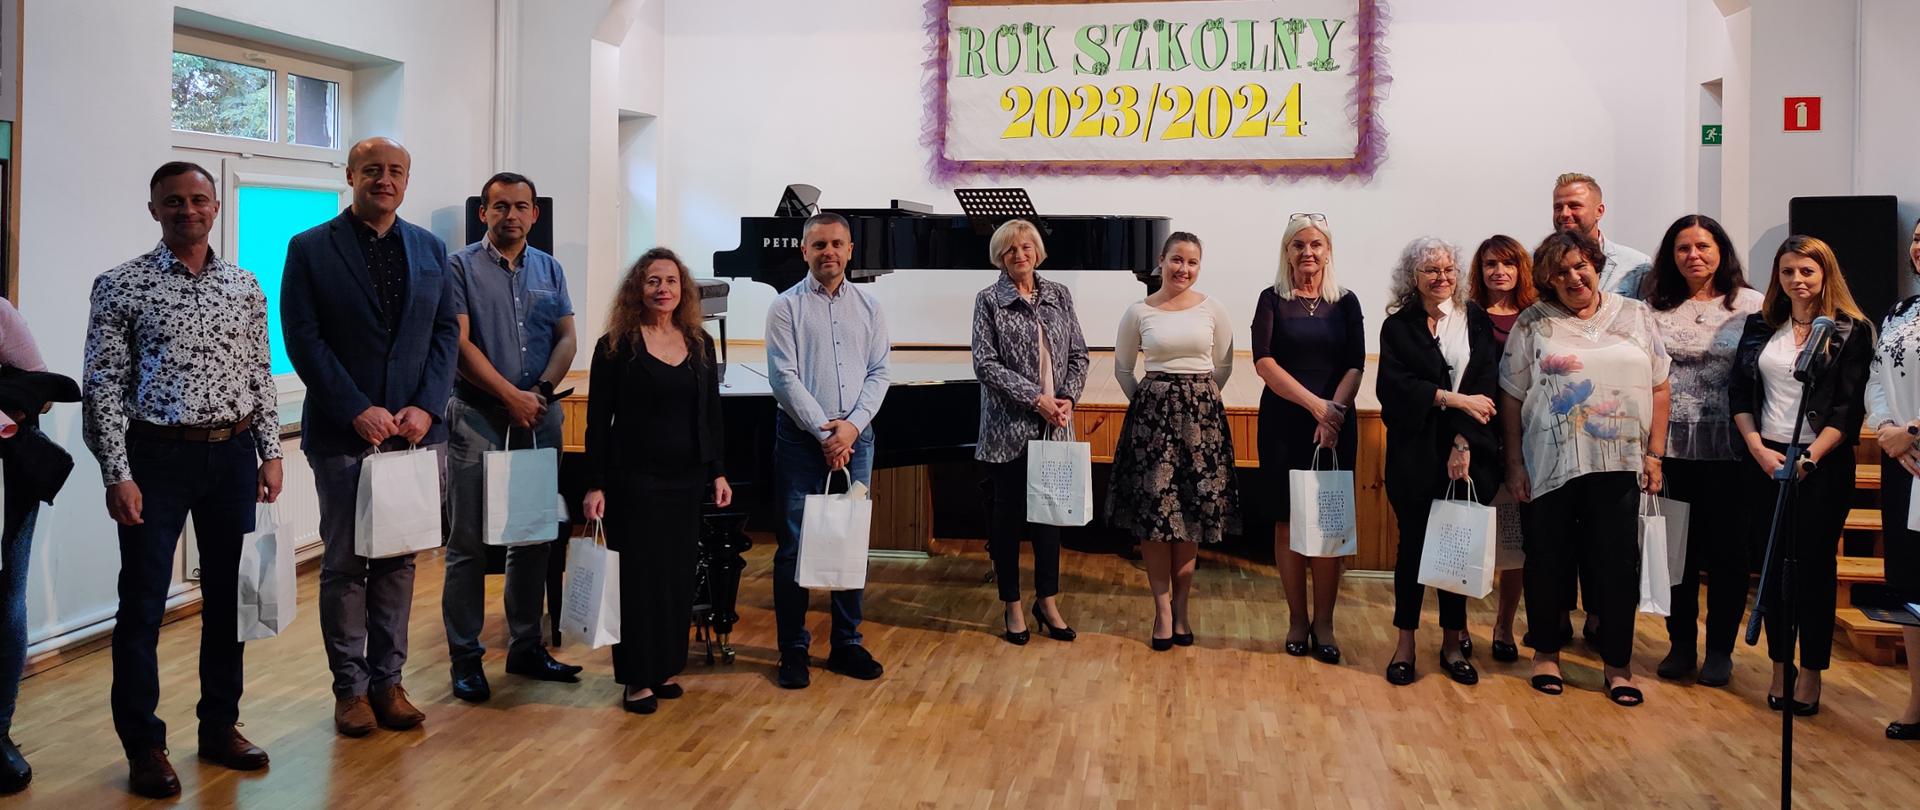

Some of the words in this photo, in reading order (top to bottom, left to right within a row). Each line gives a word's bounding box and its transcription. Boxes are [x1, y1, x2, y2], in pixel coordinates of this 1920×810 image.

[955, 21, 1057, 79] ROK
[1073, 16, 1346, 76] SZKOLNY
[1000, 82, 1308, 143] 2023/2024
[763, 237, 799, 248] PETR
